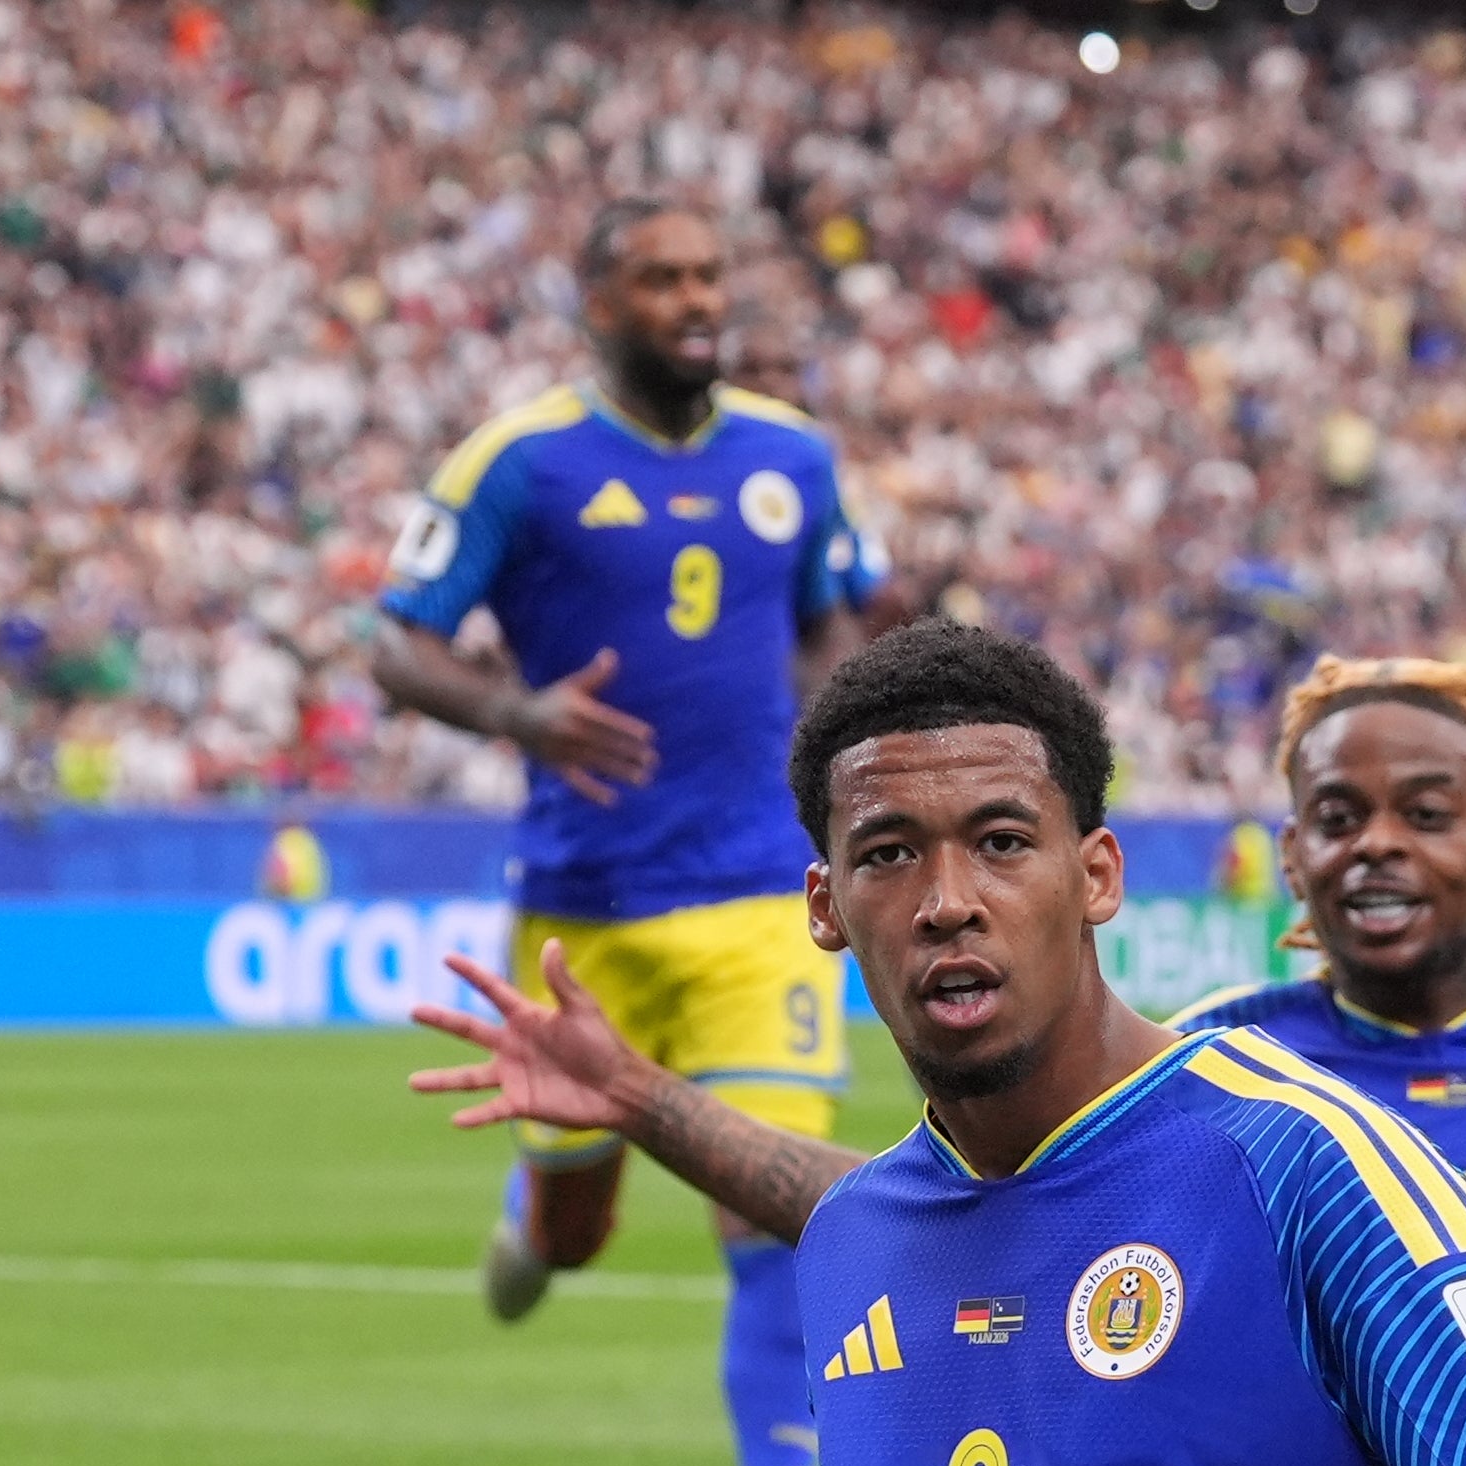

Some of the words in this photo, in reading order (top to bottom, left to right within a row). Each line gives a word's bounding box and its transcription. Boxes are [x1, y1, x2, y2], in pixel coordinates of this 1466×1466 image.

[665, 542, 724, 640] 9
[785, 983, 821, 1055] 9
[1073, 1257, 1119, 1358] Federashon
